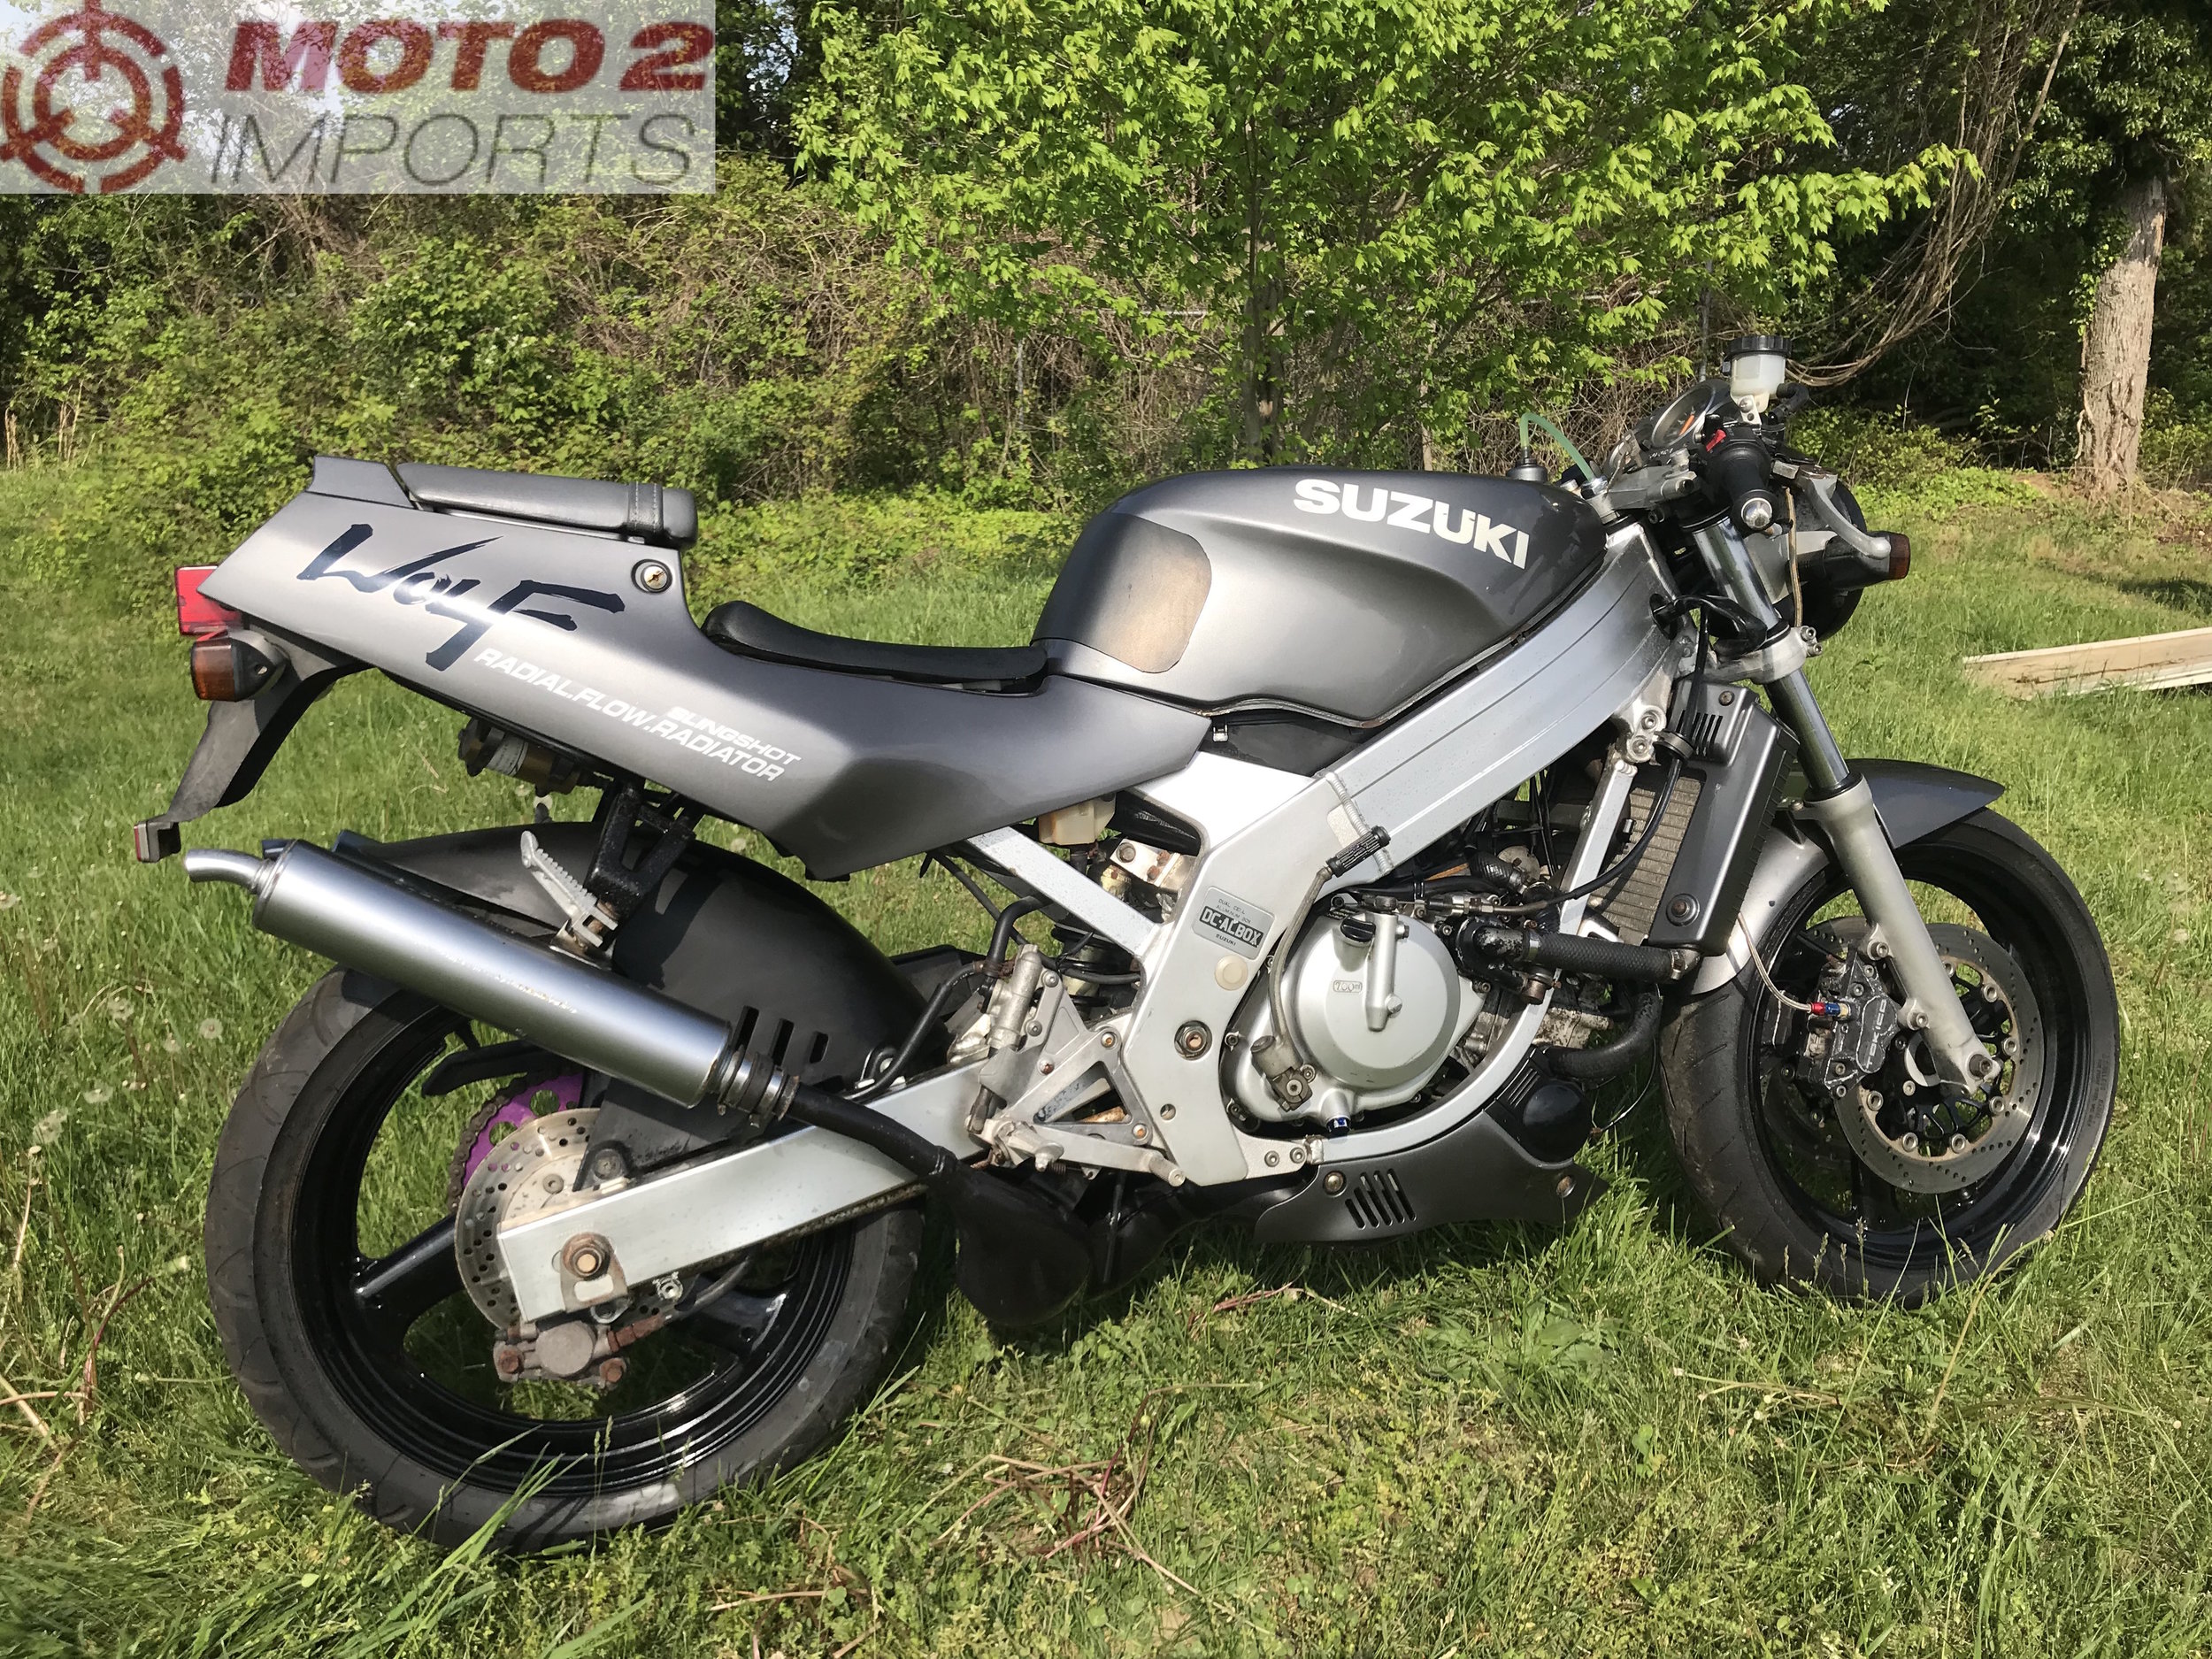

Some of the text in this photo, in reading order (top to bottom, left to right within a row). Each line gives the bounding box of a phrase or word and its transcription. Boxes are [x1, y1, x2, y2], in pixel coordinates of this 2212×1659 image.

[1294, 479, 1530, 570] SUZUKI
[665, 706, 802, 766] SLINGSHOT
[1865, 998, 1887, 1069] TOKICO
